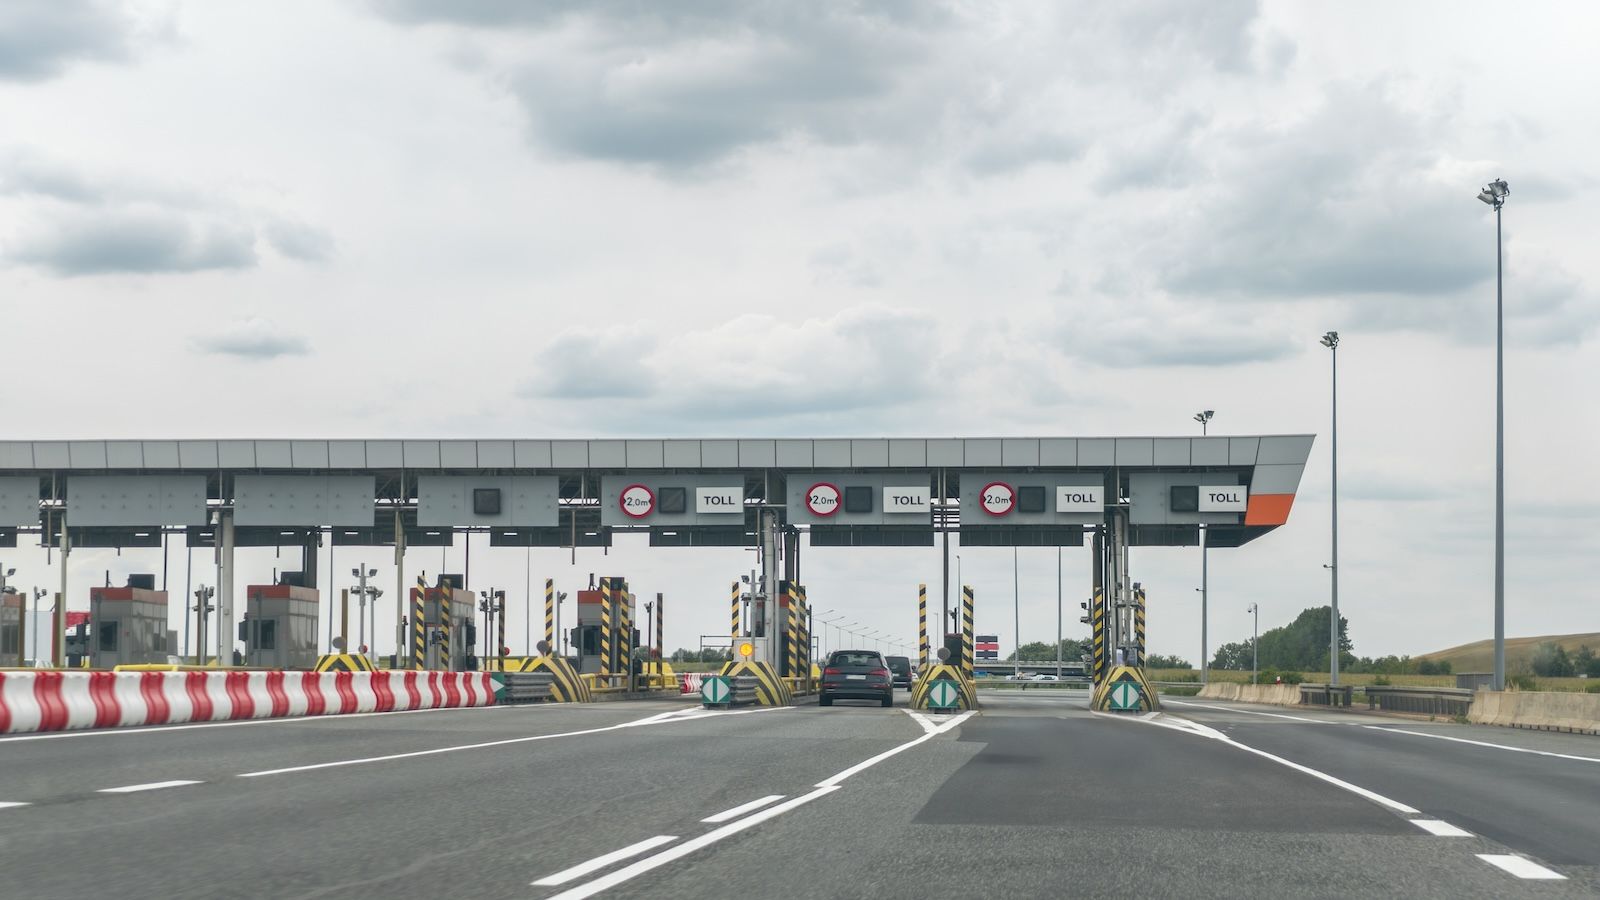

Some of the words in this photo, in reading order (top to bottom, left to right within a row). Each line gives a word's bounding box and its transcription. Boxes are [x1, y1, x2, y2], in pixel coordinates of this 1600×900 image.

[703, 495, 736, 505] TOLL
[892, 495, 925, 505] TOLL
[1064, 493, 1097, 503] TOLL
[1208, 493, 1241, 503] TOLL
